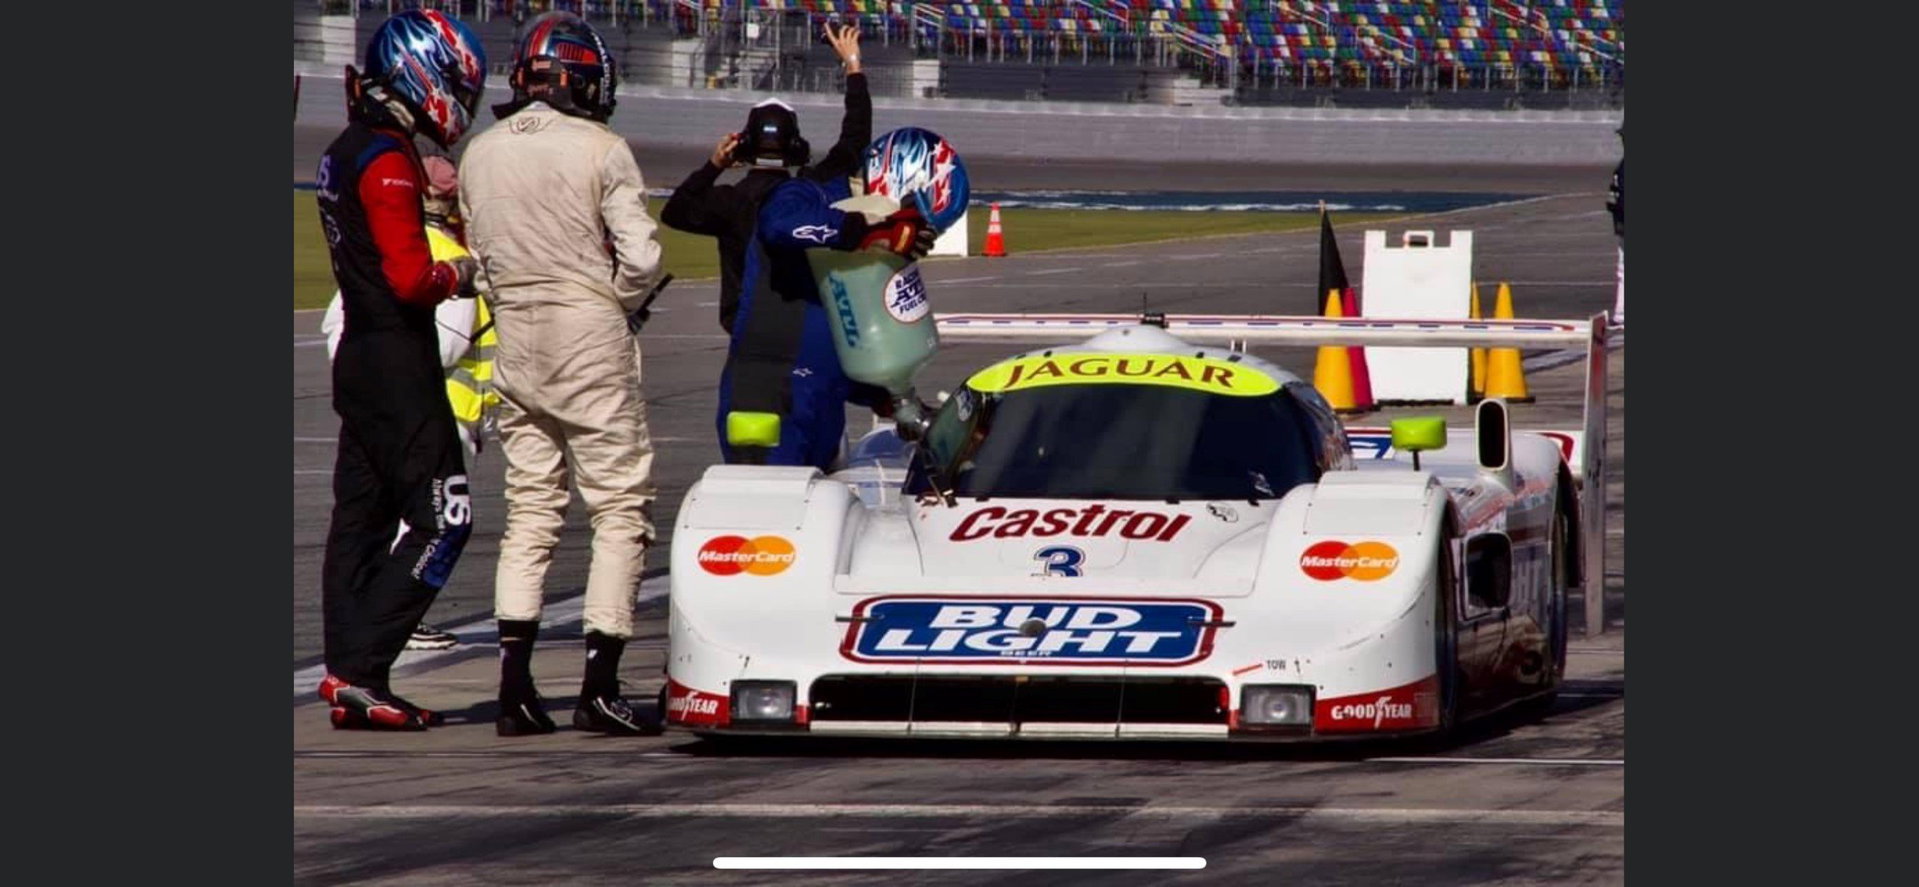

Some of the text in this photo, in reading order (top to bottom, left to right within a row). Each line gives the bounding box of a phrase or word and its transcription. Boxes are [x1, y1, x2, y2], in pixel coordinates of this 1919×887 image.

[827, 271, 860, 348] ATL
[1003, 357, 1235, 389] JAGUAR
[443, 474, 472, 525] US
[949, 504, 1192, 542] Castrol
[699, 551, 794, 563] MasterCard
[1033, 545, 1086, 577] 3
[1301, 556, 1398, 569] MasterCard
[929, 605, 1142, 630] BUD
[874, 628, 1182, 653] LIGHT
[1266, 660, 1286, 670] TOW
